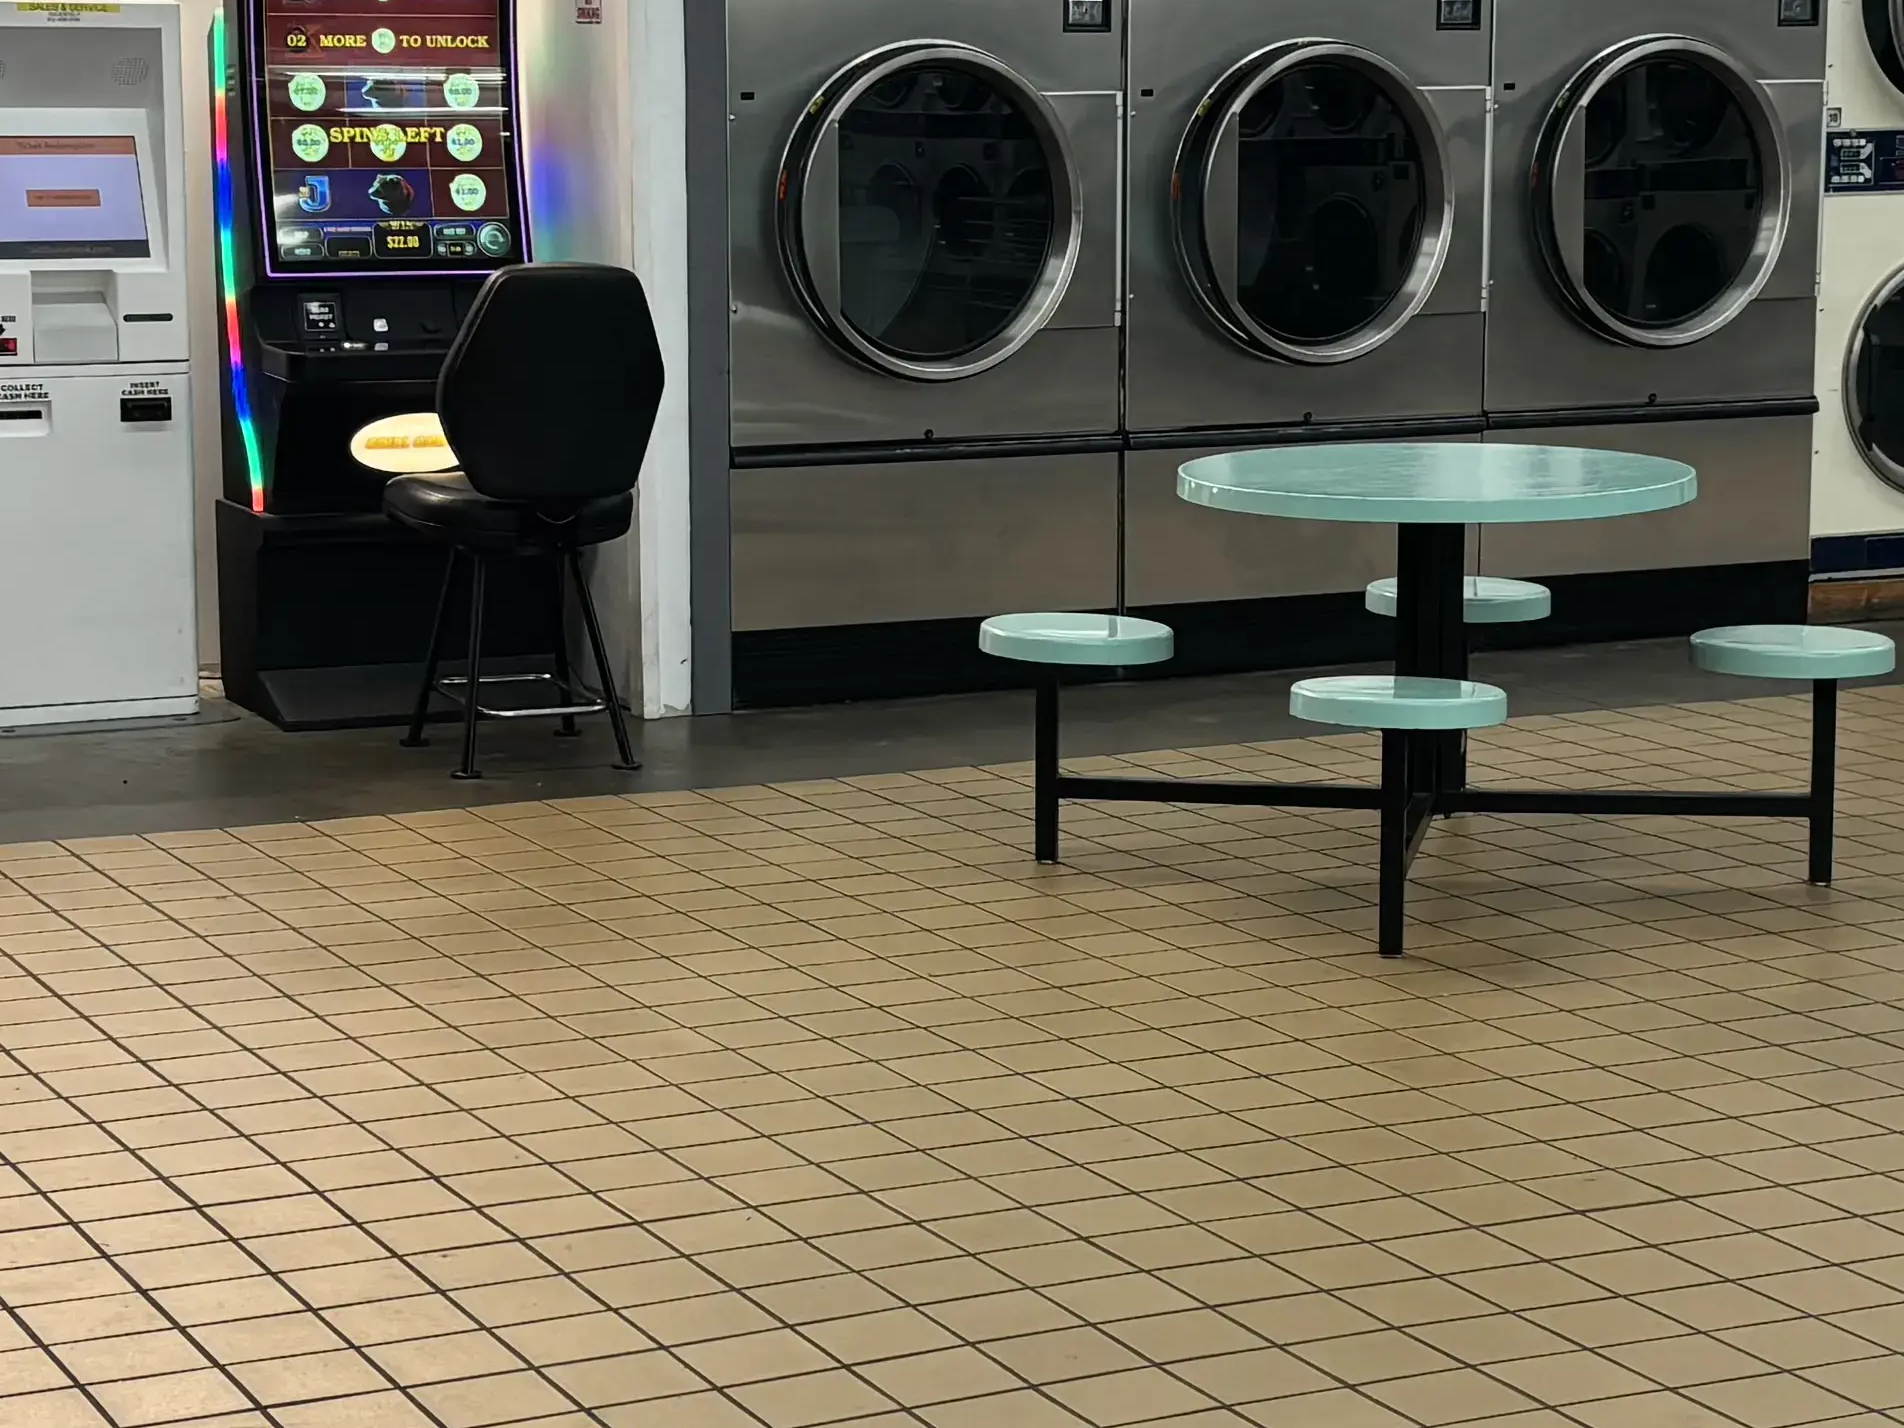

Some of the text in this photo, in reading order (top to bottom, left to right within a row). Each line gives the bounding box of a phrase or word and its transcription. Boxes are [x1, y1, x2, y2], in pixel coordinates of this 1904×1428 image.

[287, 34, 490, 48] 02 MORE TO UNLOCK
[0, 383, 44, 392] COLLECT
[23, 392, 50, 400] HERE
